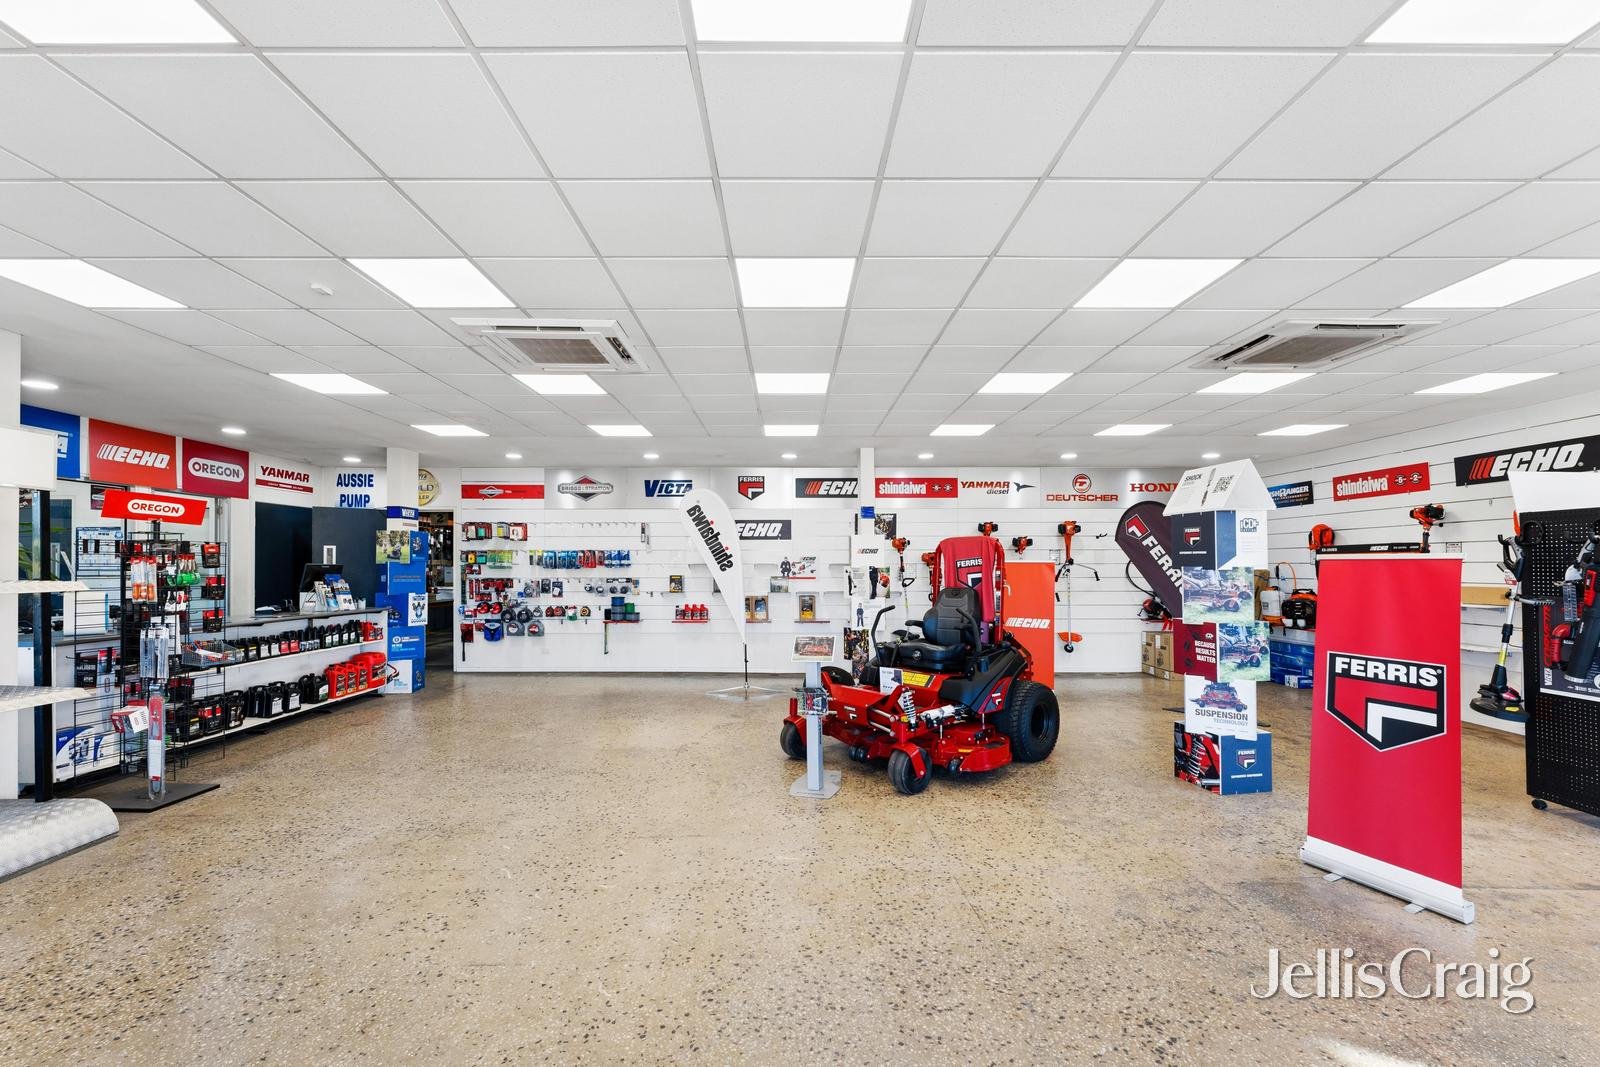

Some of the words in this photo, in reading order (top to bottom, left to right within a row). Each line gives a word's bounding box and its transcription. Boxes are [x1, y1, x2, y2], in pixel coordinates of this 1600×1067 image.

[114, 447, 170, 469] ECHO
[1490, 443, 1585, 478] ECHO
[192, 461, 240, 478] OREGON
[260, 465, 310, 483] YANMAR
[336, 473, 374, 488] AUSSIE
[960, 481, 1010, 489] YANMAR
[1336, 476, 1389, 497] shindaiwa
[818, 481, 858, 495] ECH
[879, 481, 927, 495] shindaiwa
[131, 502, 180, 514] OREGON
[339, 494, 371, 508] PUMP
[436, 513, 444, 523] 2
[957, 558, 983, 568] FERRIS
[1142, 535, 1183, 596] FERRI
[1016, 617, 1051, 629] ECHO
[1194, 640, 1216, 649] BECAUSE
[1195, 647, 1216, 656] RESULTS
[1196, 654, 1216, 663] MATTER
[1335, 656, 1438, 687] FERRIS
[1194, 708, 1248, 721] SUSPENSION
